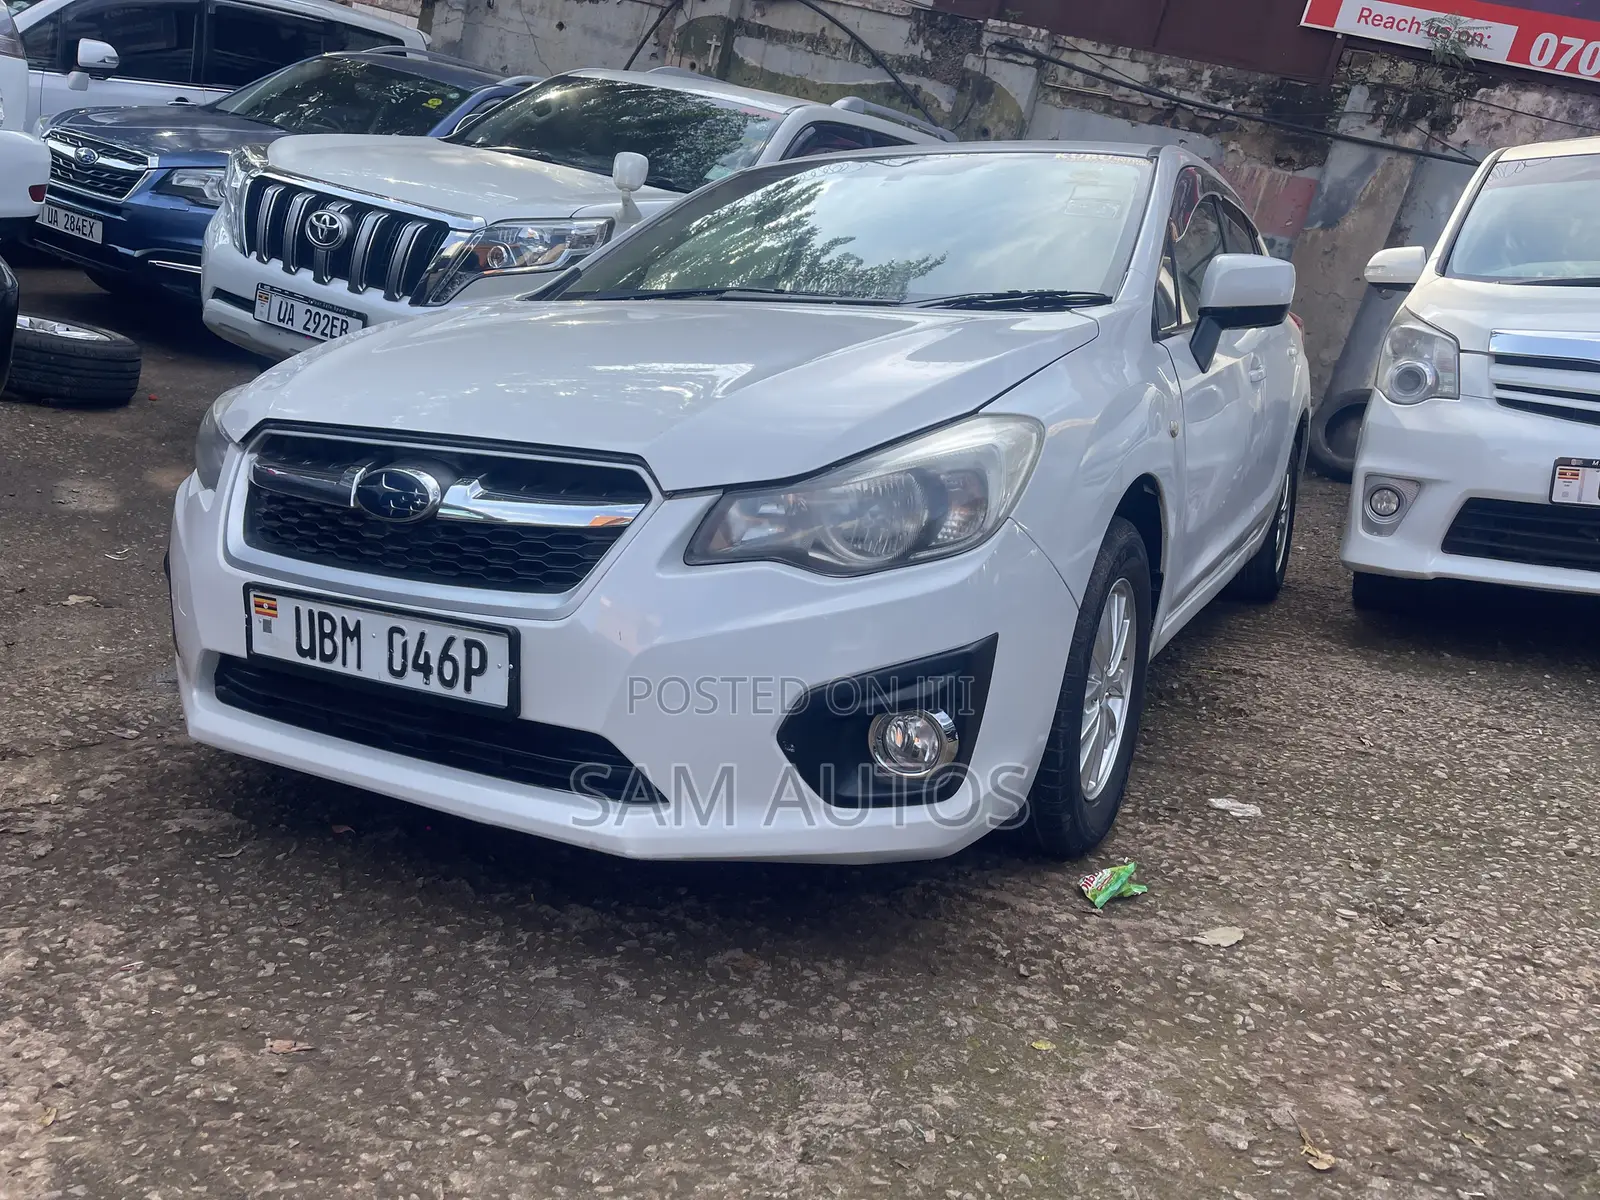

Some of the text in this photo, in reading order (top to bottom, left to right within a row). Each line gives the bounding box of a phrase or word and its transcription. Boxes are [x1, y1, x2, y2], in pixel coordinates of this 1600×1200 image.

[1356, 7, 1422, 35] Reach
[1529, 32, 1600, 76] 070
[47, 207, 59, 227] UA
[64, 213, 95, 239] 284EX
[277, 300, 295, 327] UA
[294, 605, 489, 694] UBM 046P
